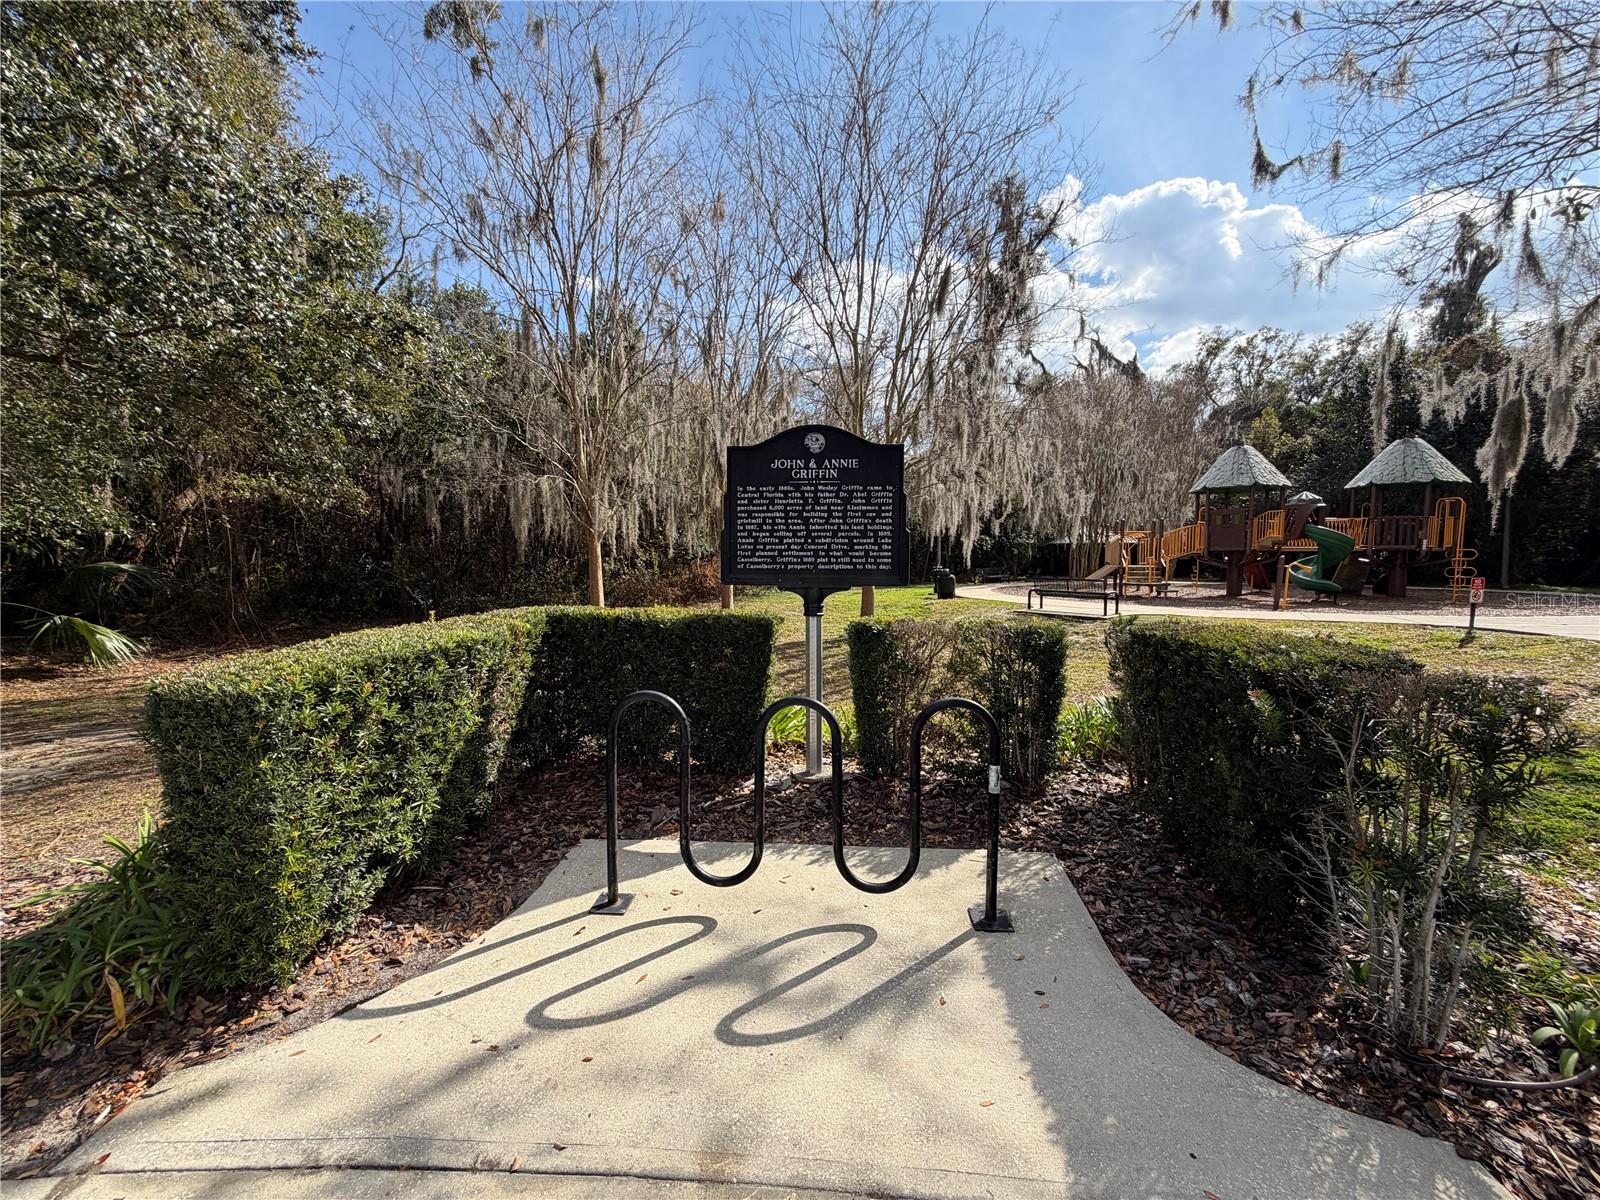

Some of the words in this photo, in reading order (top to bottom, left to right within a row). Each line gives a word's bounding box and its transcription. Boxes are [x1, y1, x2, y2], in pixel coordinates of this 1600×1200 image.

[771, 459, 805, 468] JOHN
[809, 459, 817, 468] &
[822, 459, 859, 468] ANNIE
[792, 469, 838, 479] GRIFFIN
